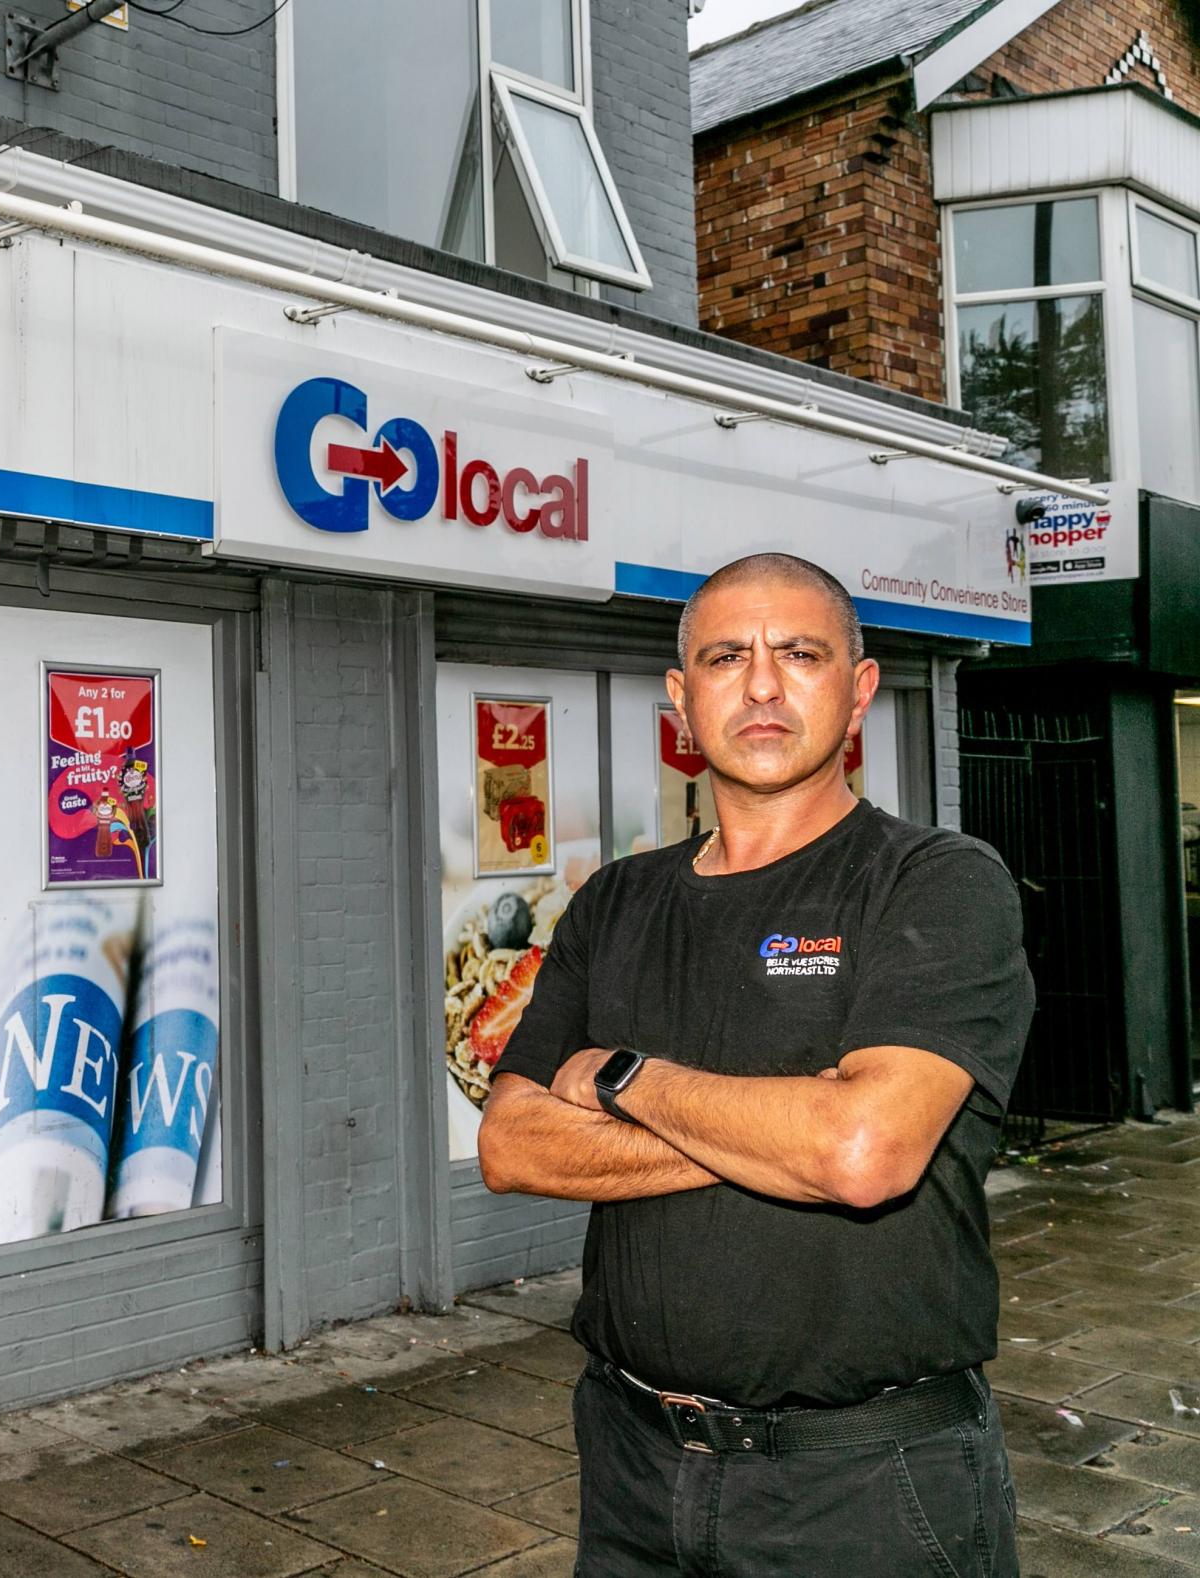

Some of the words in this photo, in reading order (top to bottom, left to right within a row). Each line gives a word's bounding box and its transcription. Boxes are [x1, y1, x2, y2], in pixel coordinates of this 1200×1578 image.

[861, 568, 928, 601] Community
[930, 579, 999, 609] Convenience
[1001, 591, 1028, 613] Store
[78, 686, 99, 700] Any
[101, 687, 108, 699] 2
[110, 687, 126, 699] for
[74, 705, 133, 740] £1.80
[492, 723, 536, 751] £2.25
[50, 750, 102, 769] Feeling
[67, 765, 118, 786] fruity?
[60, 797, 88, 809] taste
[766, 957, 789, 967] BELLE
[791, 957, 807, 967] VUE
[808, 955, 840, 967] STORES
[817, 965, 836, 976] LTD
